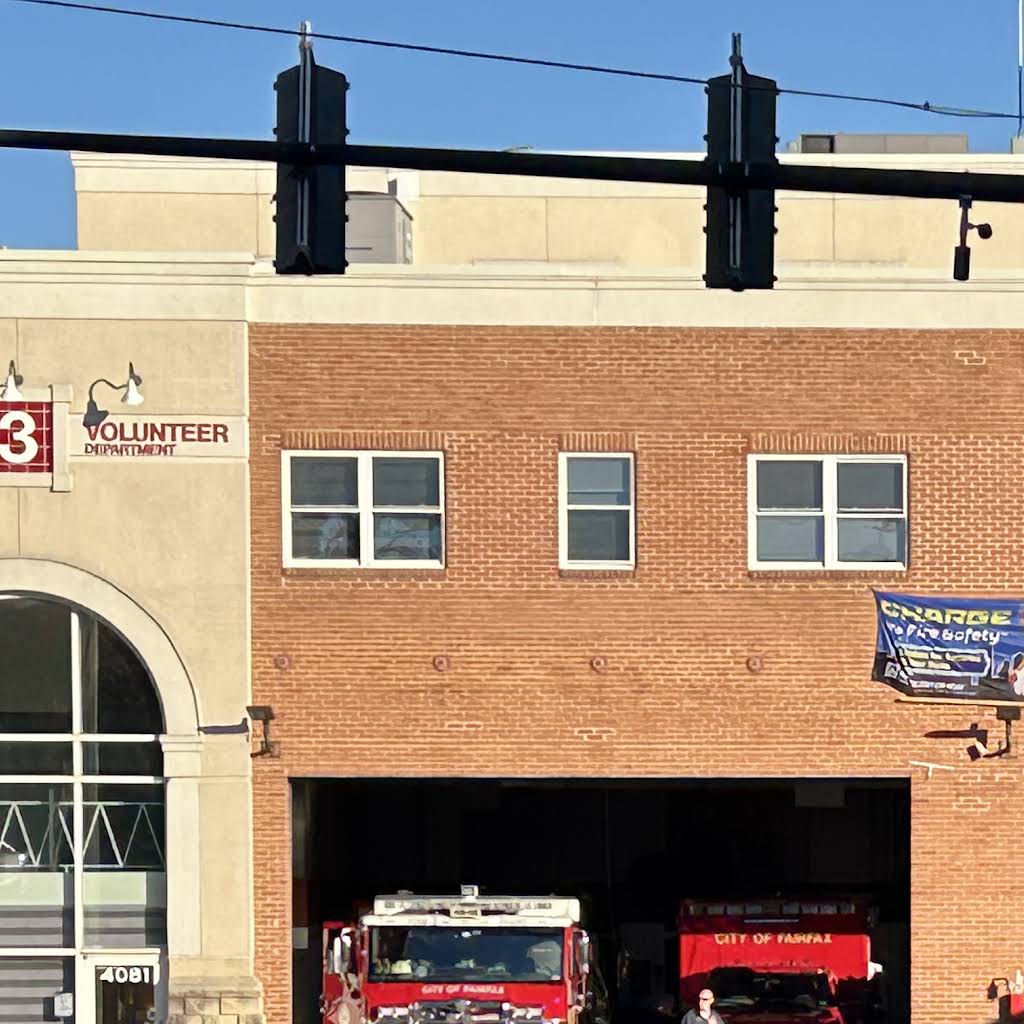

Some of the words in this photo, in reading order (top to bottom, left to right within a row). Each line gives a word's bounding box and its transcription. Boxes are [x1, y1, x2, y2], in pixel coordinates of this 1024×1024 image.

[0, 410, 38, 463] 3
[86, 421, 230, 443] VOLUNTEER
[714, 933, 747, 945] CITY
[752, 933, 772, 945] OF
[100, 966, 150, 984] 4081
